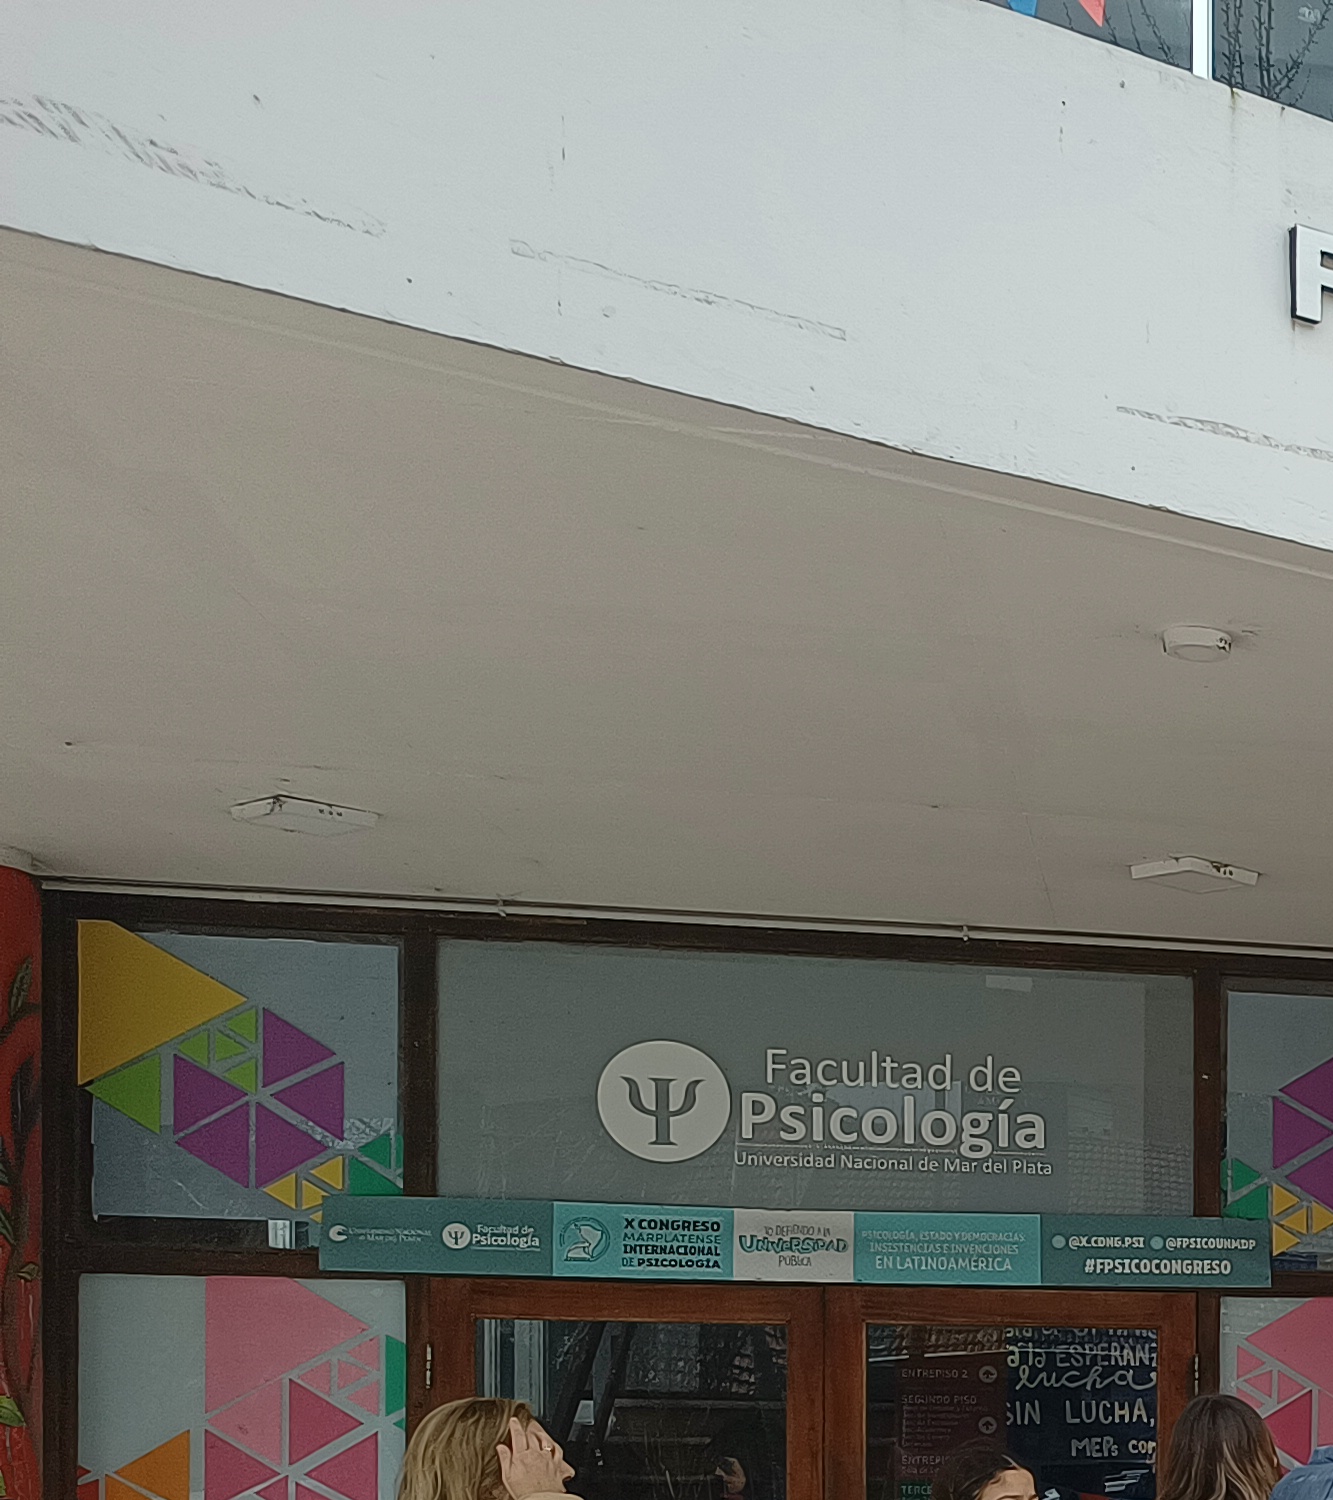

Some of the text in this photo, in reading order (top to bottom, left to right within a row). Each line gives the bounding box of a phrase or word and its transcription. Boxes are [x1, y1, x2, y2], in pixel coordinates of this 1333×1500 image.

[765, 1049, 1022, 1093] Facultad de
[740, 1092, 1046, 1159] Psicología
[734, 1151, 1053, 1176] Universidad Nacional de Mar del Plata
[477, 1224, 534, 1234] Facultad de
[624, 1218, 721, 1232] X CONGRESO
[472, 1230, 540, 1248] Psicología
[622, 1232, 721, 1244] MARPLATENSE
[919, 1231, 953, 1241] ESTADO
[870, 1242, 1019, 1255] INSISTENCIAS E INVENCIONES
[1165, 1237, 1256, 1250] @FPSICOUNMDP
[623, 1244, 721, 1257] INTERNACIONAL
[622, 1256, 721, 1269] DE PSICOLOGÍA
[875, 1254, 1013, 1272] EN LATINOAMÉRICA
[1084, 1258, 1232, 1275] #FPSICOCONGRESO
[961, 1369, 969, 1379] 2
[1015, 1364, 1157, 1391] lucha
[953, 1395, 977, 1405] PISO
[1065, 1397, 1155, 1428] LUCHA,
